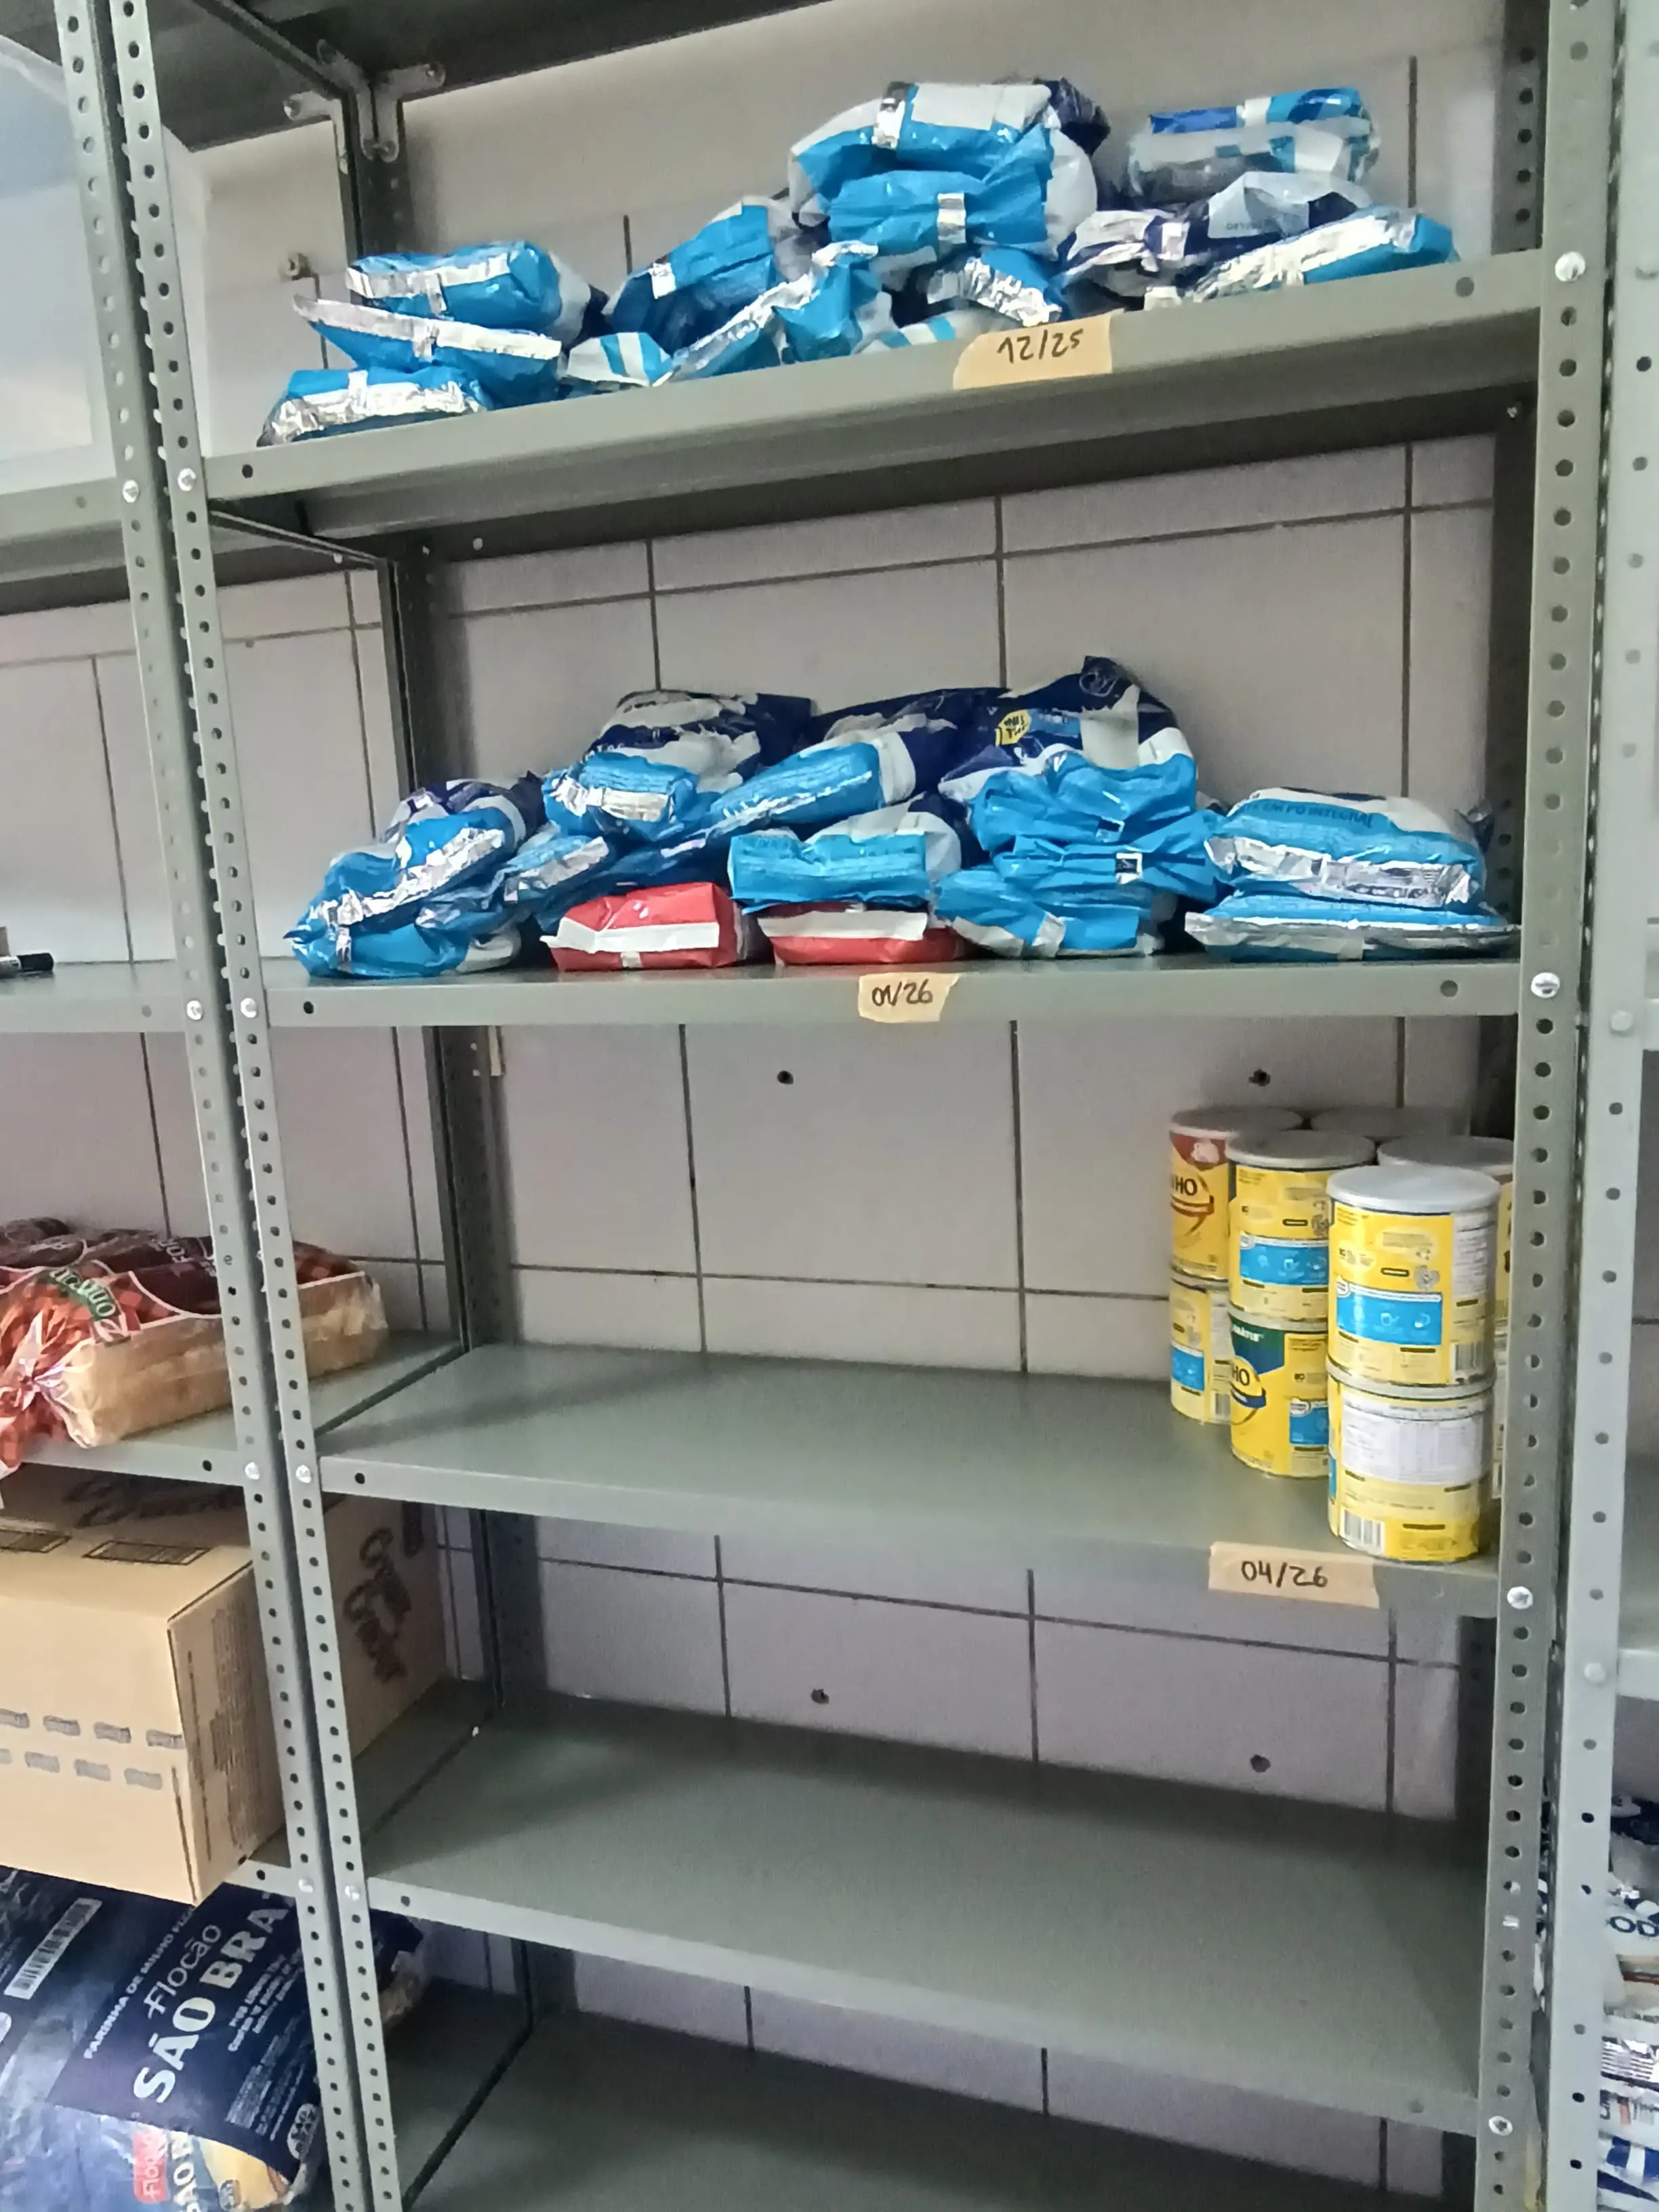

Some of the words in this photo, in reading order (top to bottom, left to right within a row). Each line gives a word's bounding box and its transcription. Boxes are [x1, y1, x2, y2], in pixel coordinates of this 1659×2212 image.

[997, 328, 1084, 364] 12/25
[872, 978, 933, 1007] 01/26
[1242, 1560, 1328, 1588] 04/26
[143, 1924, 222, 2020] Flocão
[134, 1996, 217, 2104] SÃO
